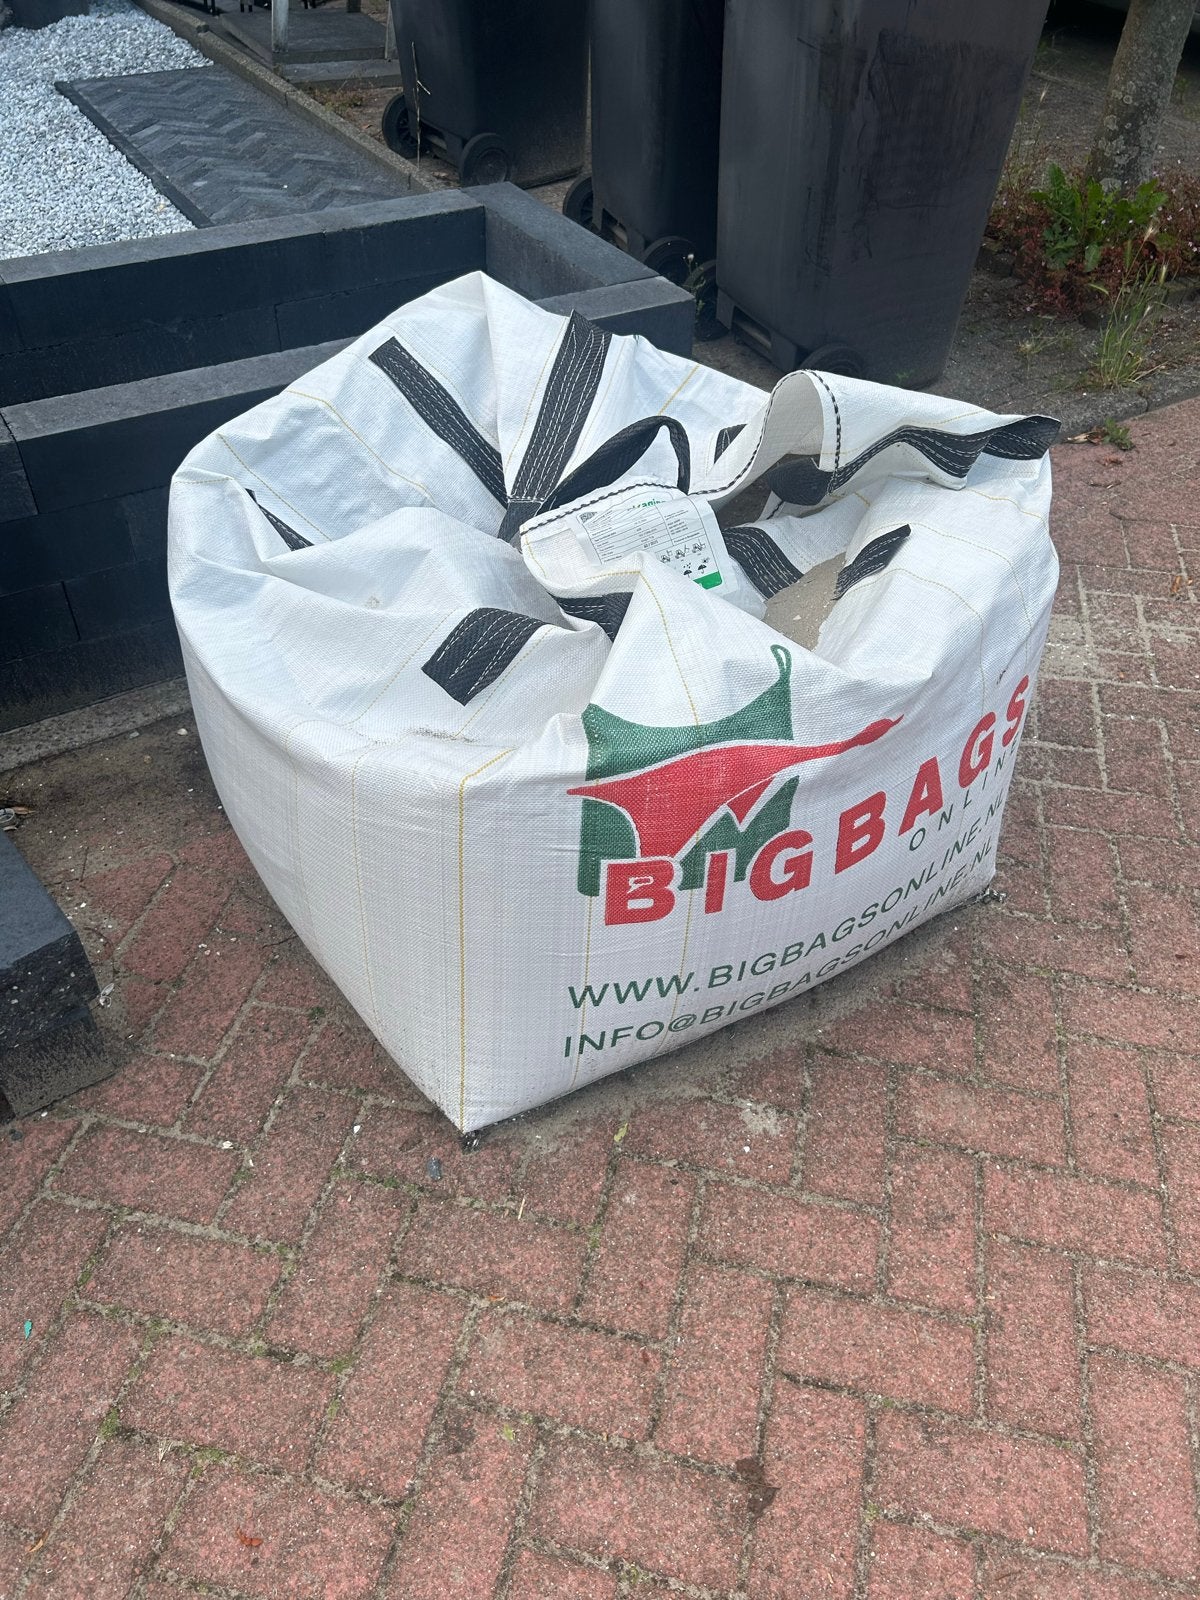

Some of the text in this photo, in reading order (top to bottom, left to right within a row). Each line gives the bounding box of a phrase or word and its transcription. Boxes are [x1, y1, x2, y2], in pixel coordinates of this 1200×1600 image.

[567, 787, 1003, 1009] WWW.BIGBAGSONLINE.NL
[908, 731, 1020, 852] ONLINE
[564, 835, 993, 1058] INFO@BIGBAGSONLINE.NL
